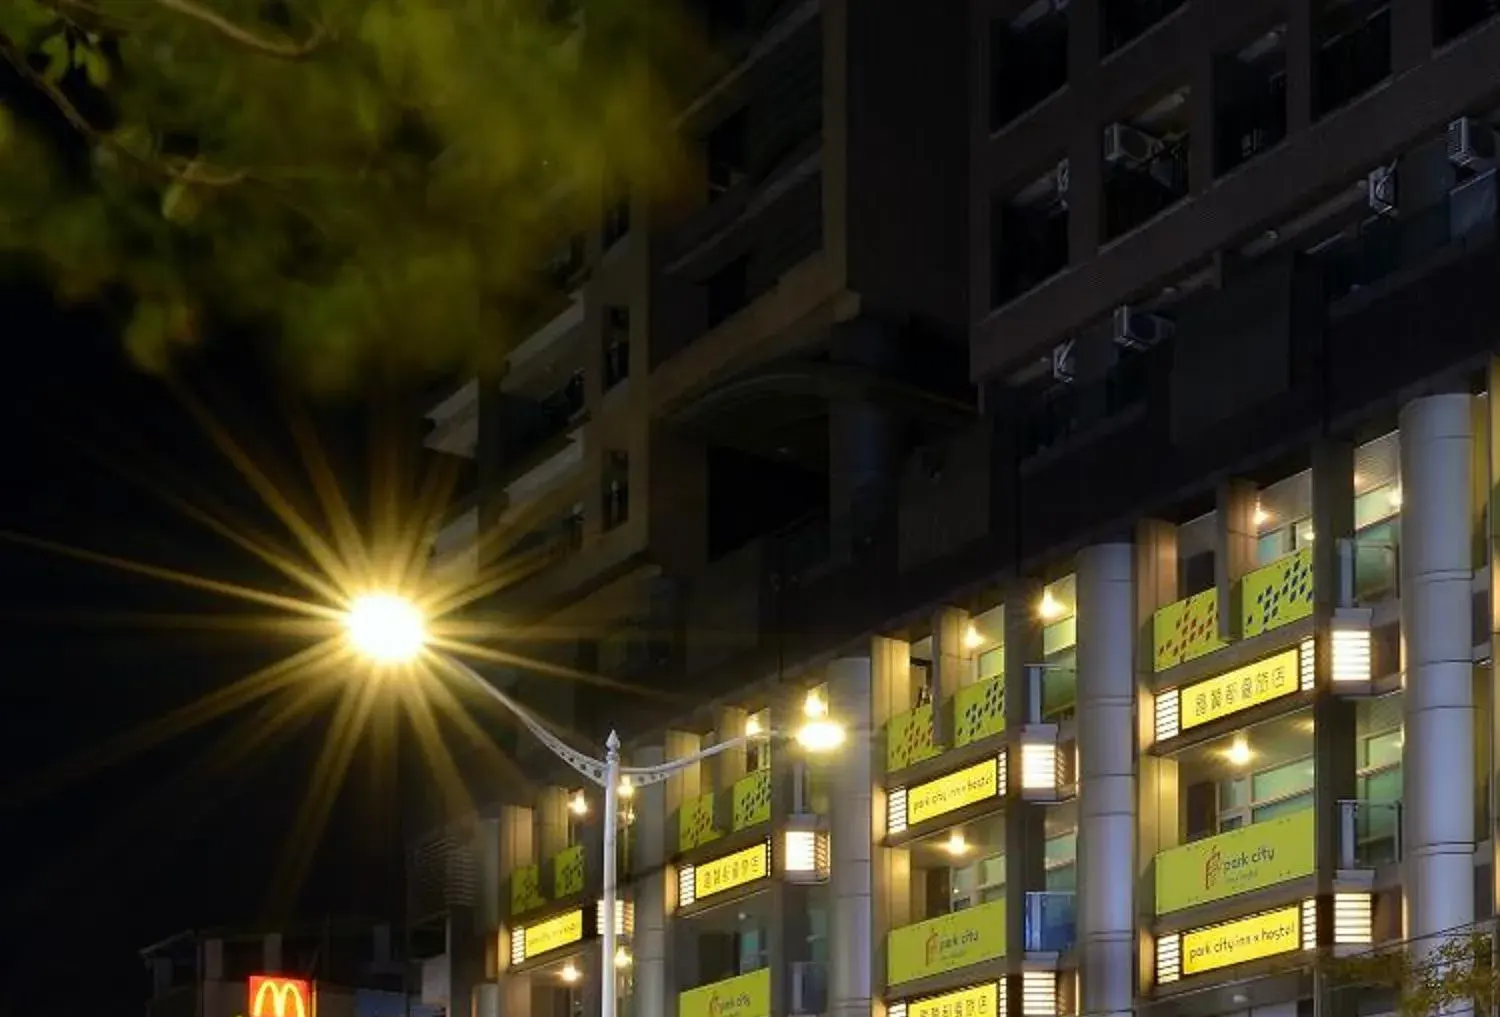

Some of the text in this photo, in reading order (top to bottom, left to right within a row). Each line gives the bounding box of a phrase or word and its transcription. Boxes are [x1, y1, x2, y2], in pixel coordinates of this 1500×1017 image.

[1189, 942, 1211, 964] park
[1213, 937, 1234, 953] city
[1262, 920, 1295, 941] hostel
